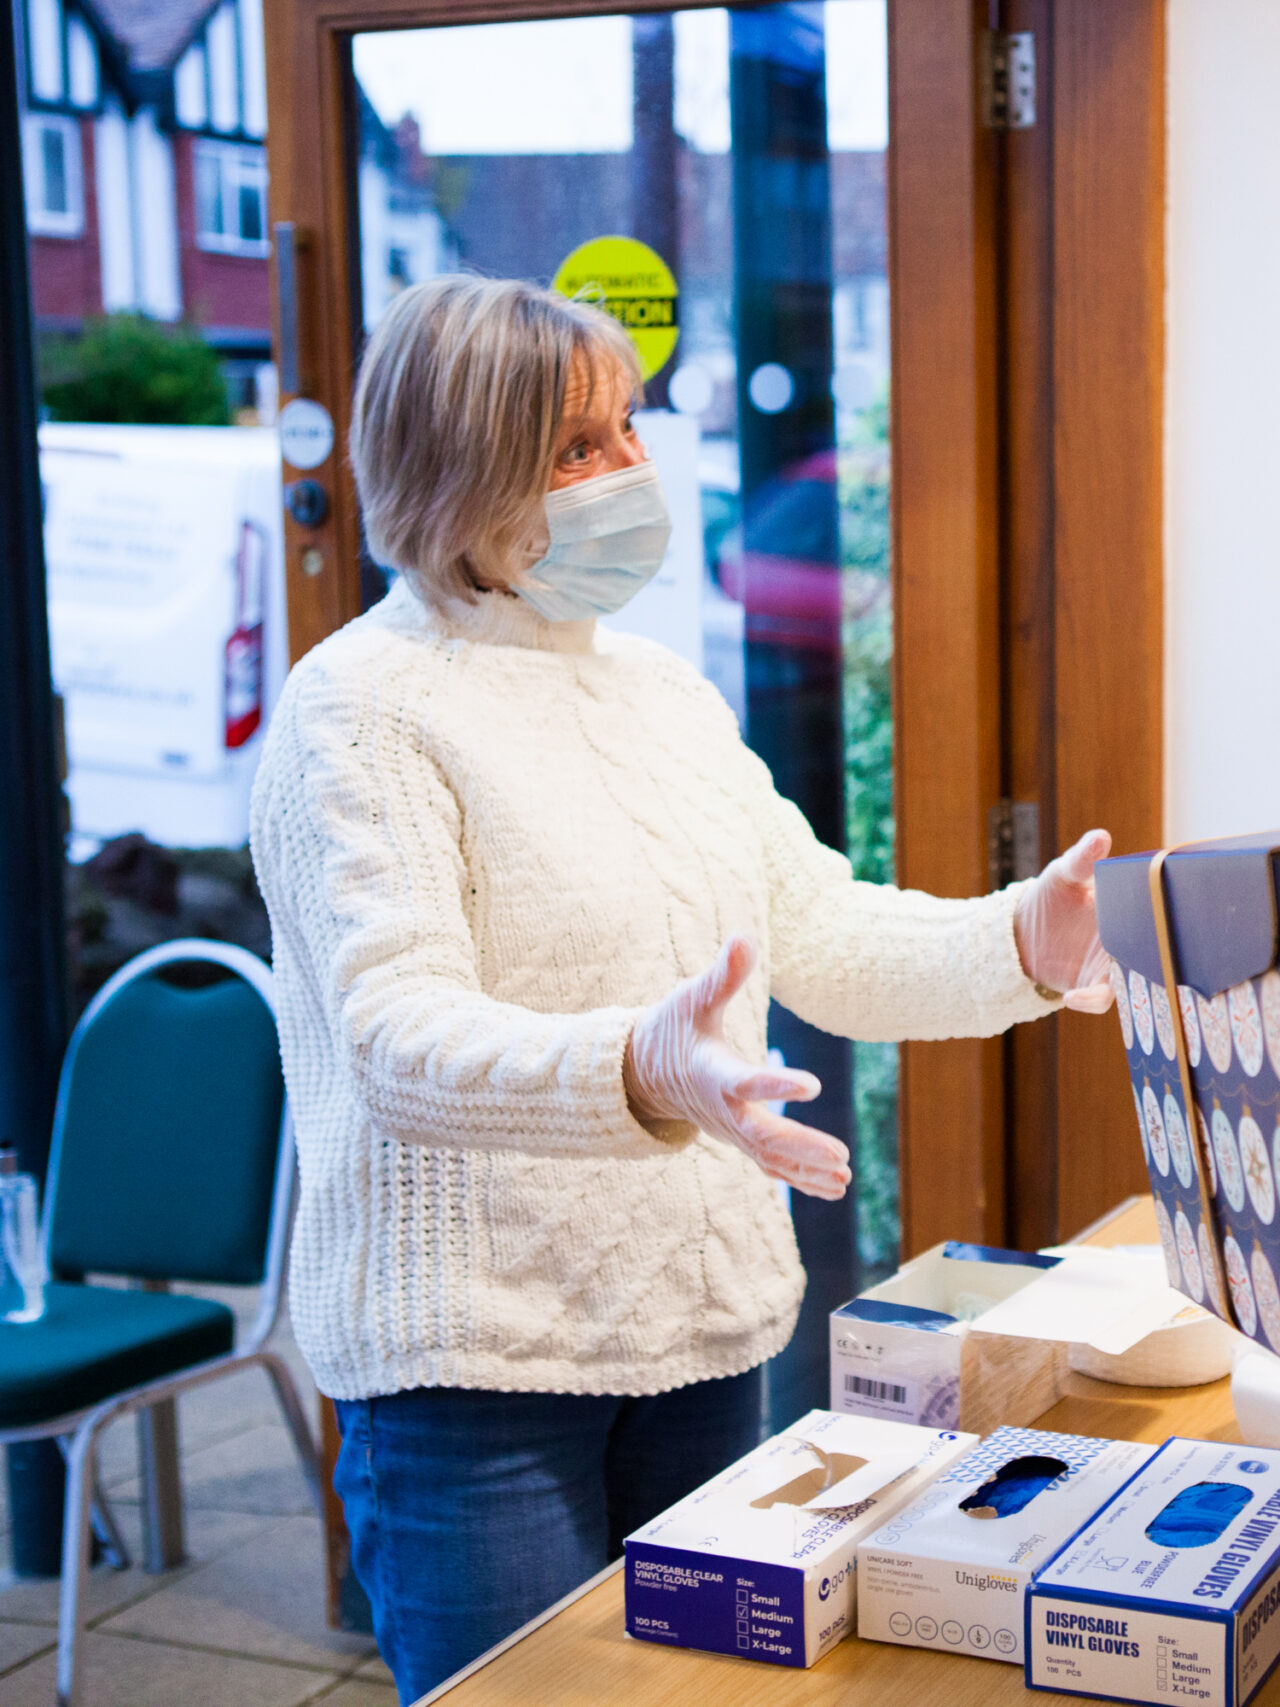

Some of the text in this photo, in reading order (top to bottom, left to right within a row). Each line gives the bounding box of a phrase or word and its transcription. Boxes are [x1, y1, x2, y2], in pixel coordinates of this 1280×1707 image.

[1229, 1518, 1279, 1552] VINYL
[896, 1560, 913, 1568] SOFT
[635, 1561, 724, 1583] DISPOSABLE CLEAR
[635, 1570, 699, 1587] VINYL GLOVES
[1192, 1552, 1251, 1599] GLOVES
[635, 1579, 677, 1592] Powder free
[737, 1578, 755, 1587] Size:
[956, 1571, 1018, 1592] Unigloves
[751, 1594, 780, 1606] Small
[635, 1617, 669, 1629] 100 PCS
[751, 1609, 794, 1624] Medium
[752, 1624, 781, 1638] Large
[1046, 1611, 1128, 1637] DISPOSABLE
[752, 1640, 792, 1655] X-Large
[1046, 1630, 1140, 1658] VINYL GLOVES
[1158, 1636, 1178, 1645] Size:
[1046, 1656, 1075, 1667] Quantity
[1172, 1650, 1198, 1661] Small
[1066, 1669, 1082, 1677] PCS
[1172, 1661, 1211, 1675] Medium
[1172, 1673, 1200, 1685] Large
[1172, 1684, 1211, 1699] X-Large
